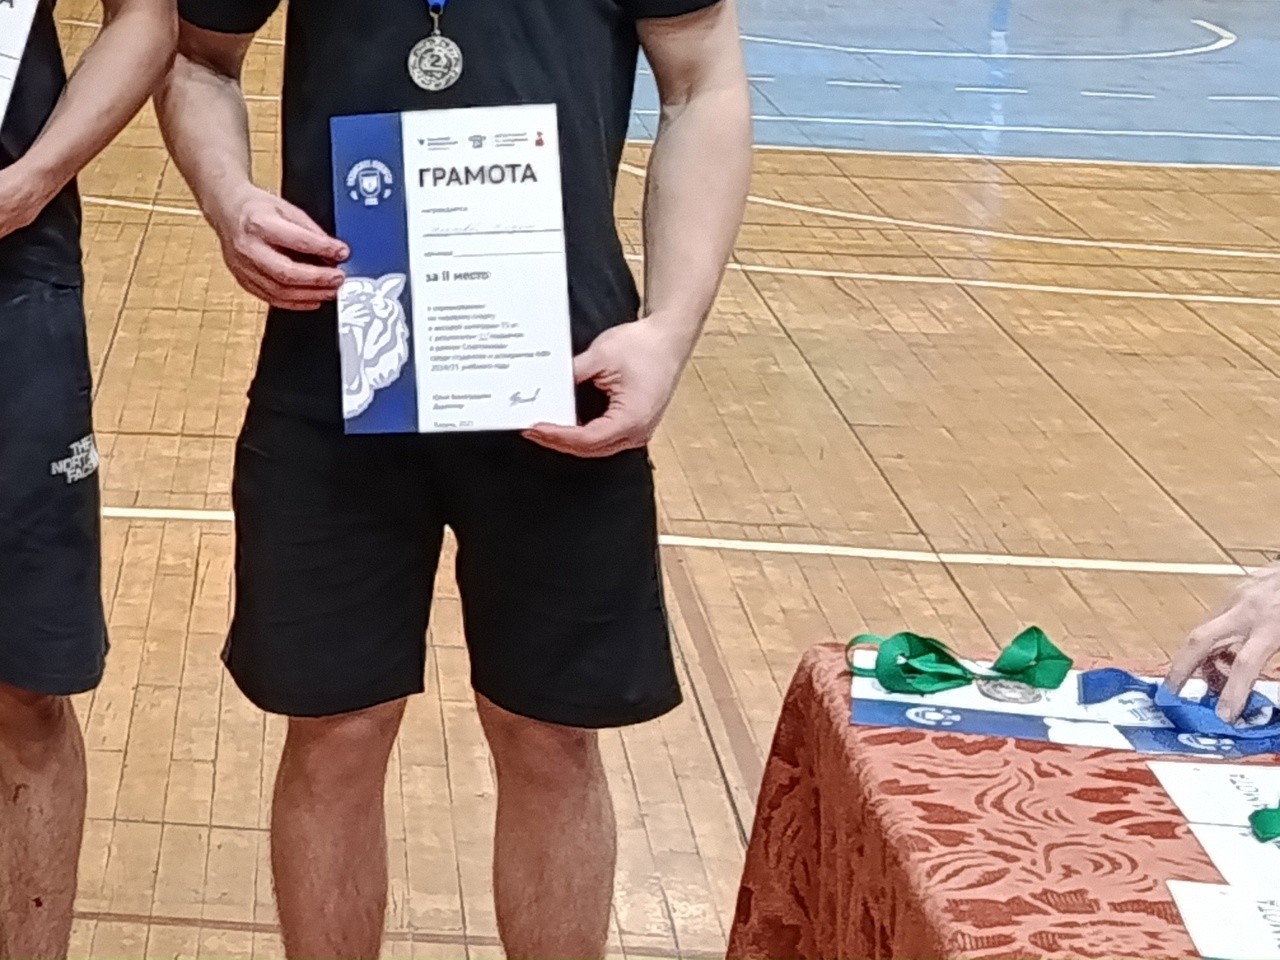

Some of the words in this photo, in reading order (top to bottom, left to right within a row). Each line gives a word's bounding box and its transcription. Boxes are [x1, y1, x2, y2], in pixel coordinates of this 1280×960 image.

[429, 54, 442, 68] 2
[418, 162, 538, 188] ГРАМОТА
[425, 272, 439, 283] за
[442, 270, 450, 282] II
[453, 271, 491, 282] место
